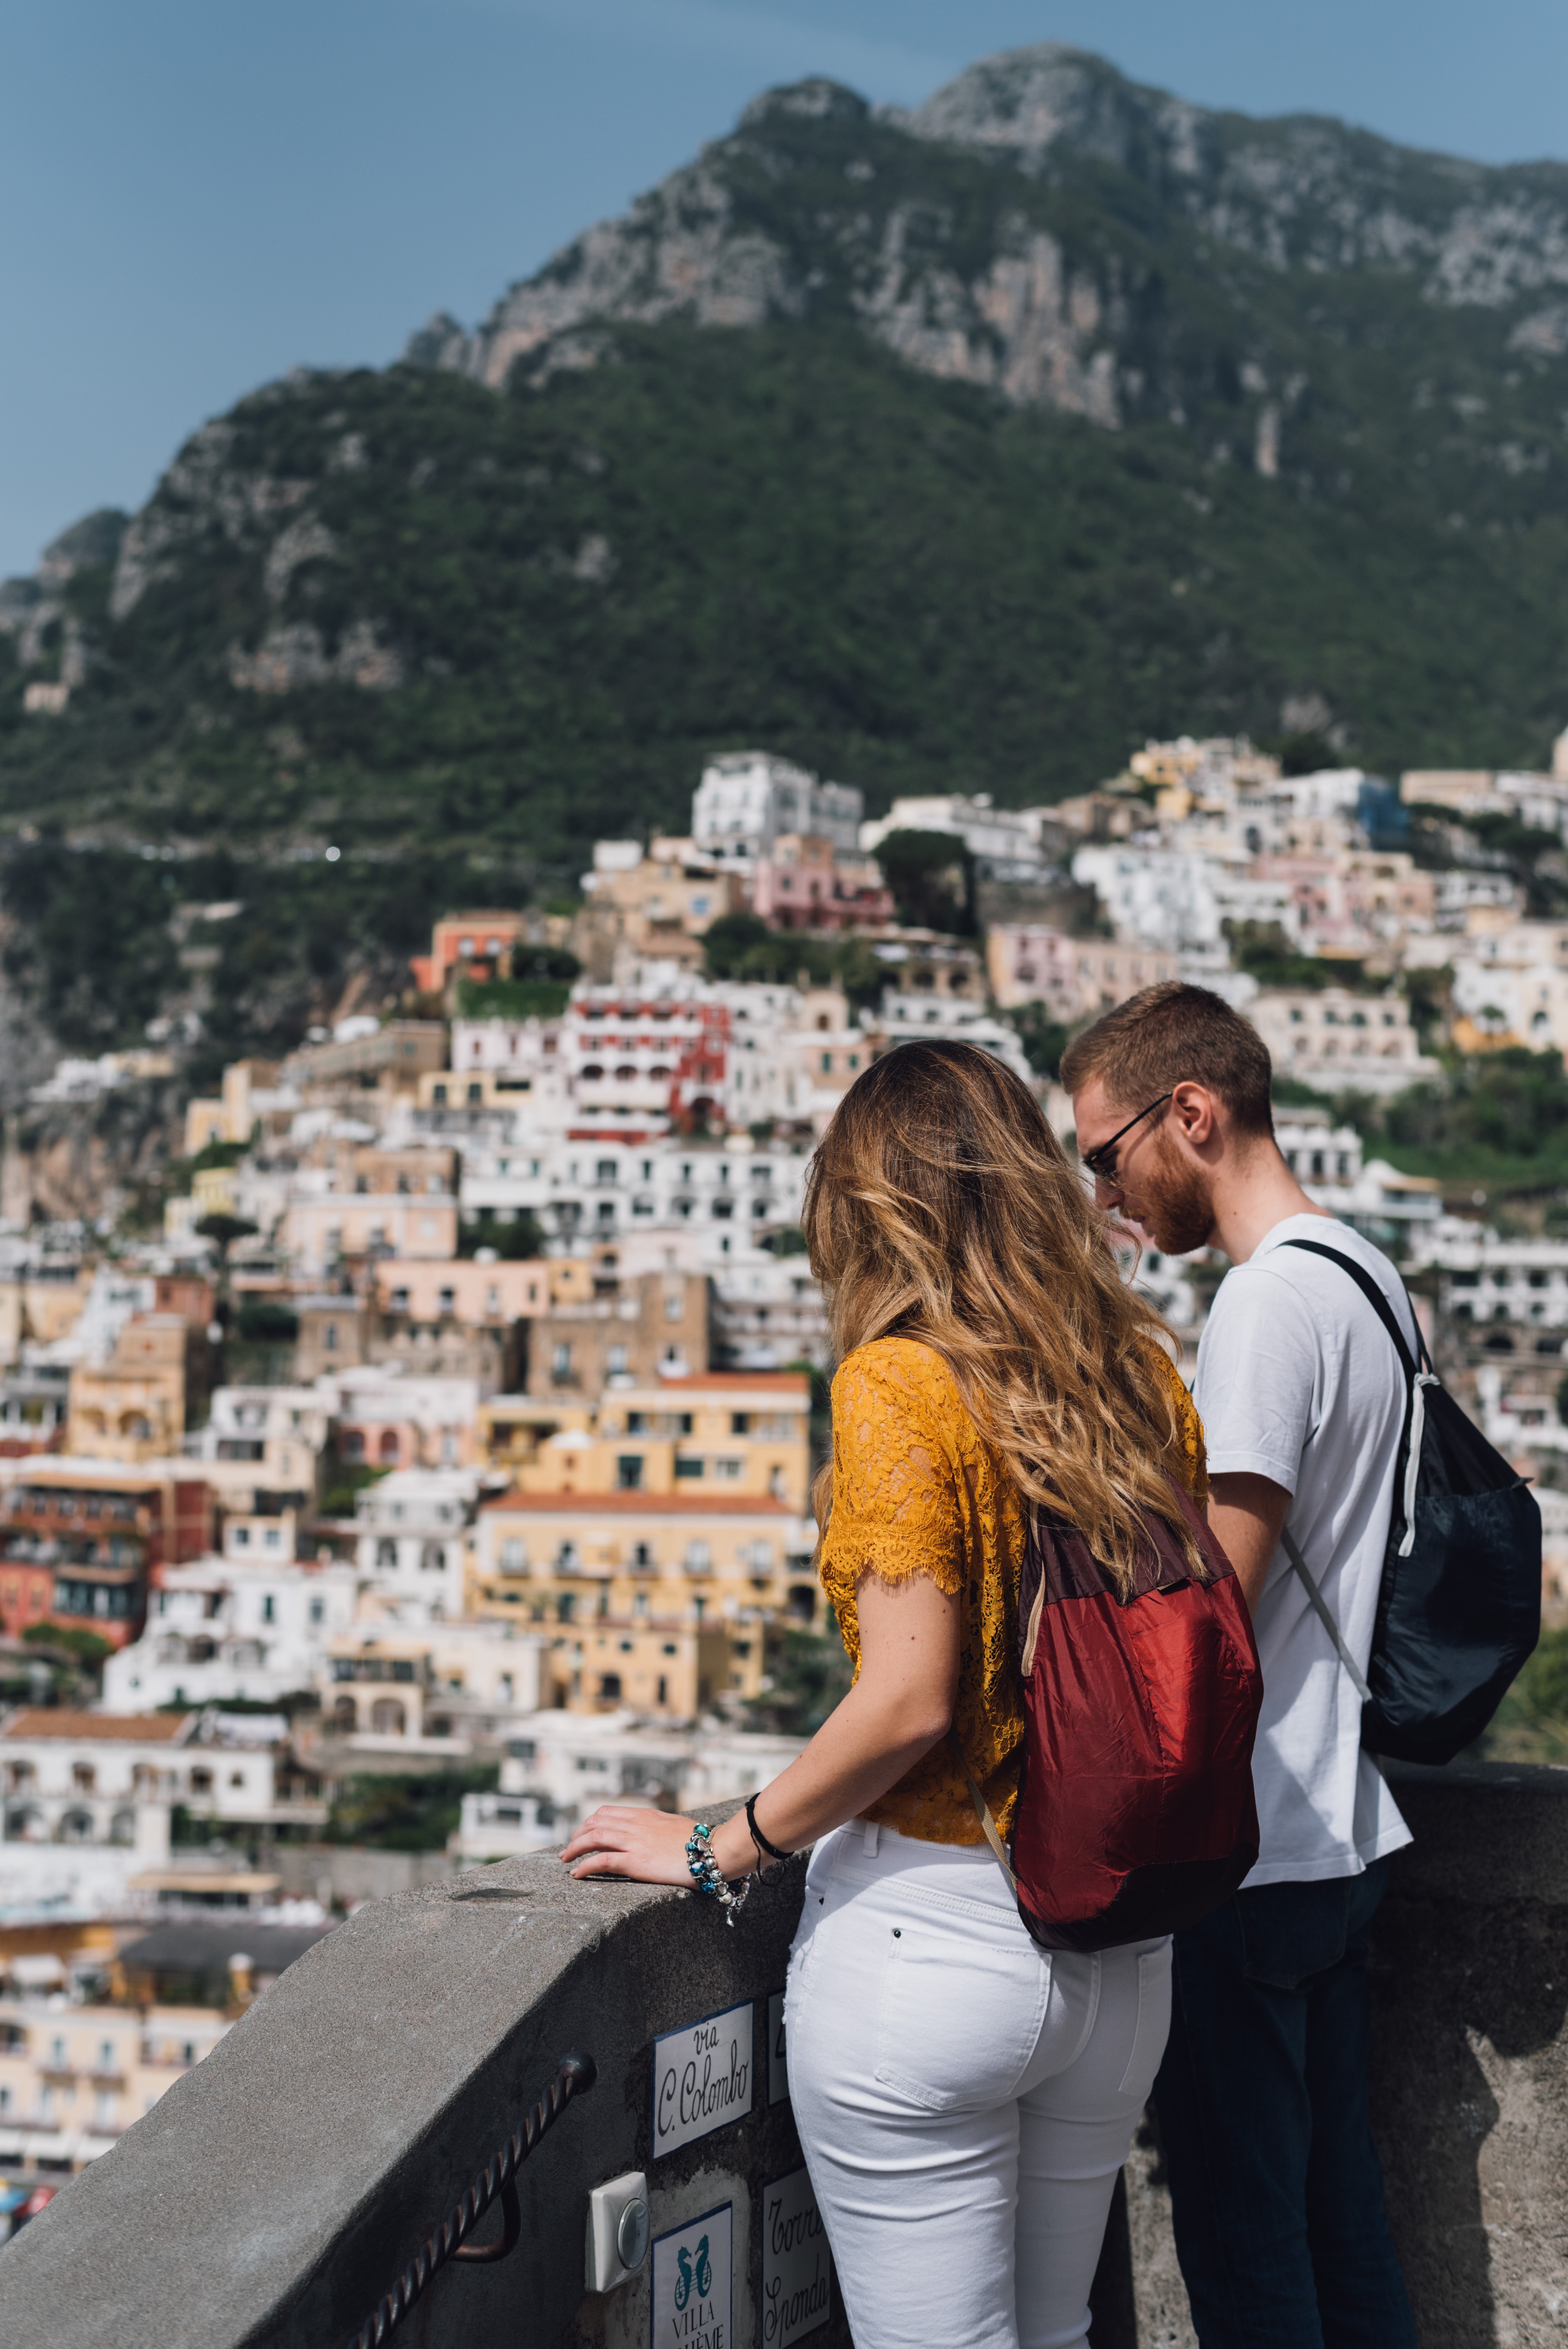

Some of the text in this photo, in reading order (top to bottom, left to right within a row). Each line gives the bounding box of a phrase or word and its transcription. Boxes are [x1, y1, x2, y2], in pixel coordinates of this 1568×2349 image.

[693, 2022, 720, 2055] via
[680, 2039, 749, 2124] Colombo
[672, 2300, 715, 2339] VILLA
[764, 2252, 829, 2348] Sponda
